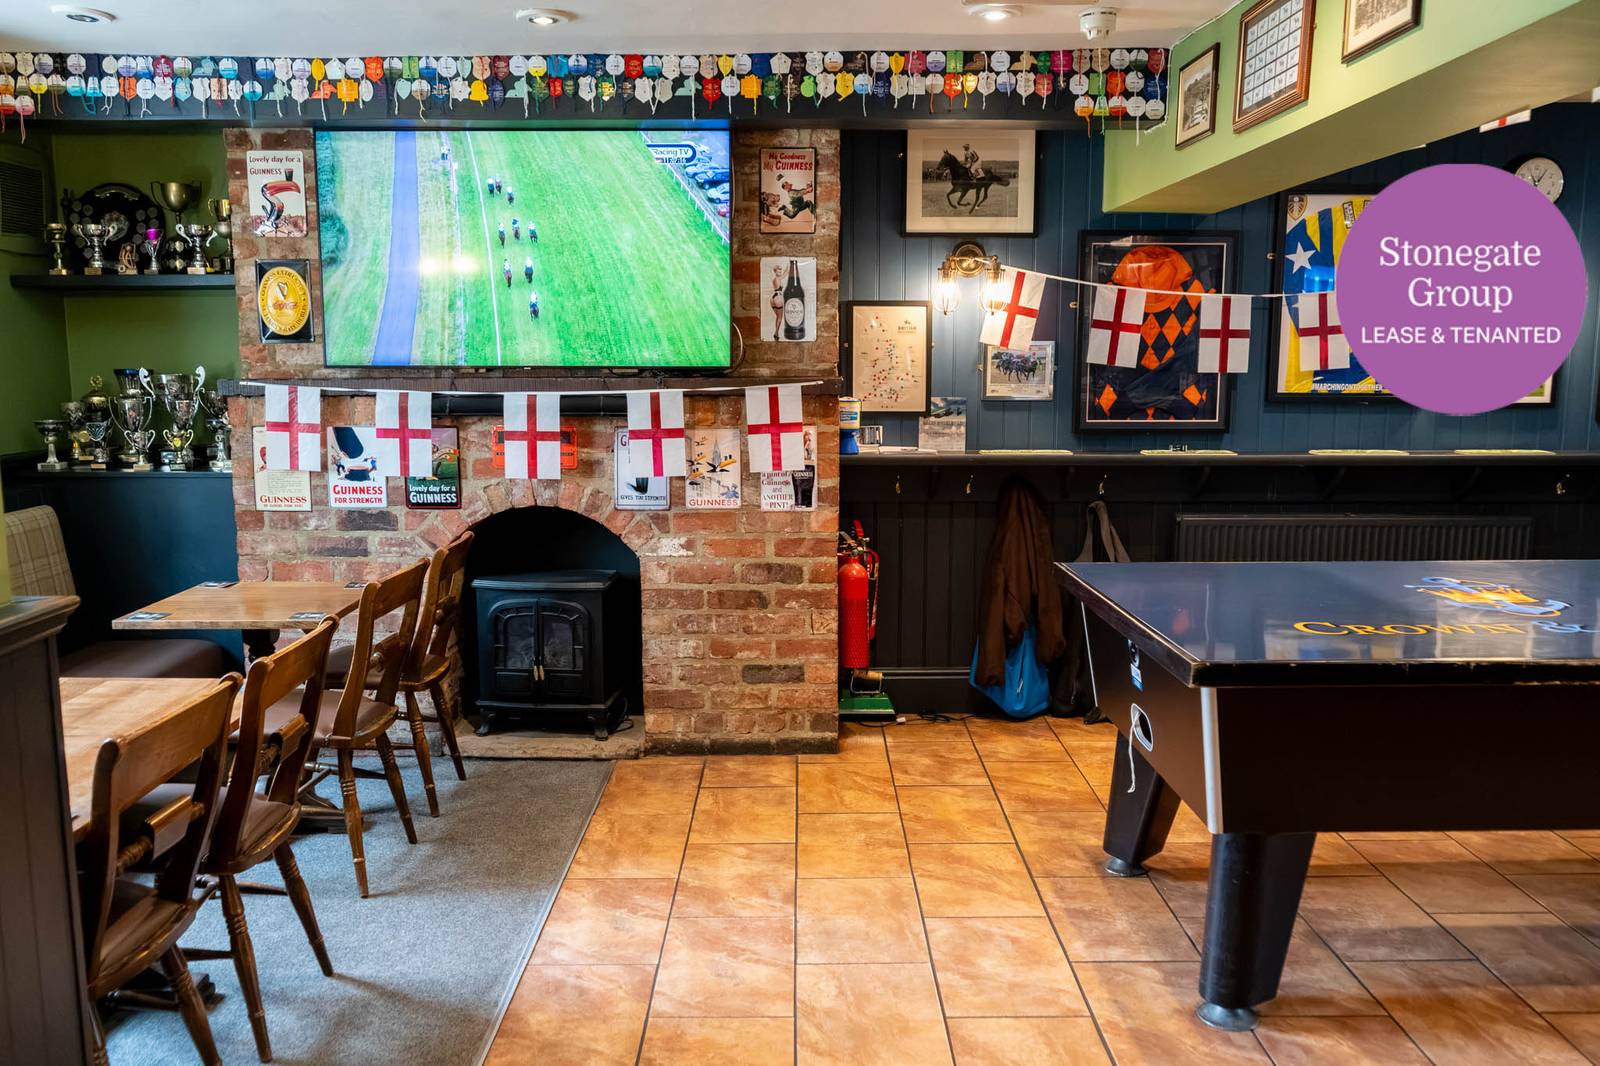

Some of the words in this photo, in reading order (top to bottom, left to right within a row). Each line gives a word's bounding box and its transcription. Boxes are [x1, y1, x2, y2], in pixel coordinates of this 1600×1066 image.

[652, 149, 678, 157] Racing
[769, 153, 777, 161] My
[776, 161, 813, 171] GUINNESS
[332, 484, 384, 495] GUINNESS
[260, 495, 307, 504] GUINNESS
[409, 492, 457, 504] GUINNESS
[689, 499, 738, 507] GUINNESS
[1293, 621, 1528, 636] CROWN
